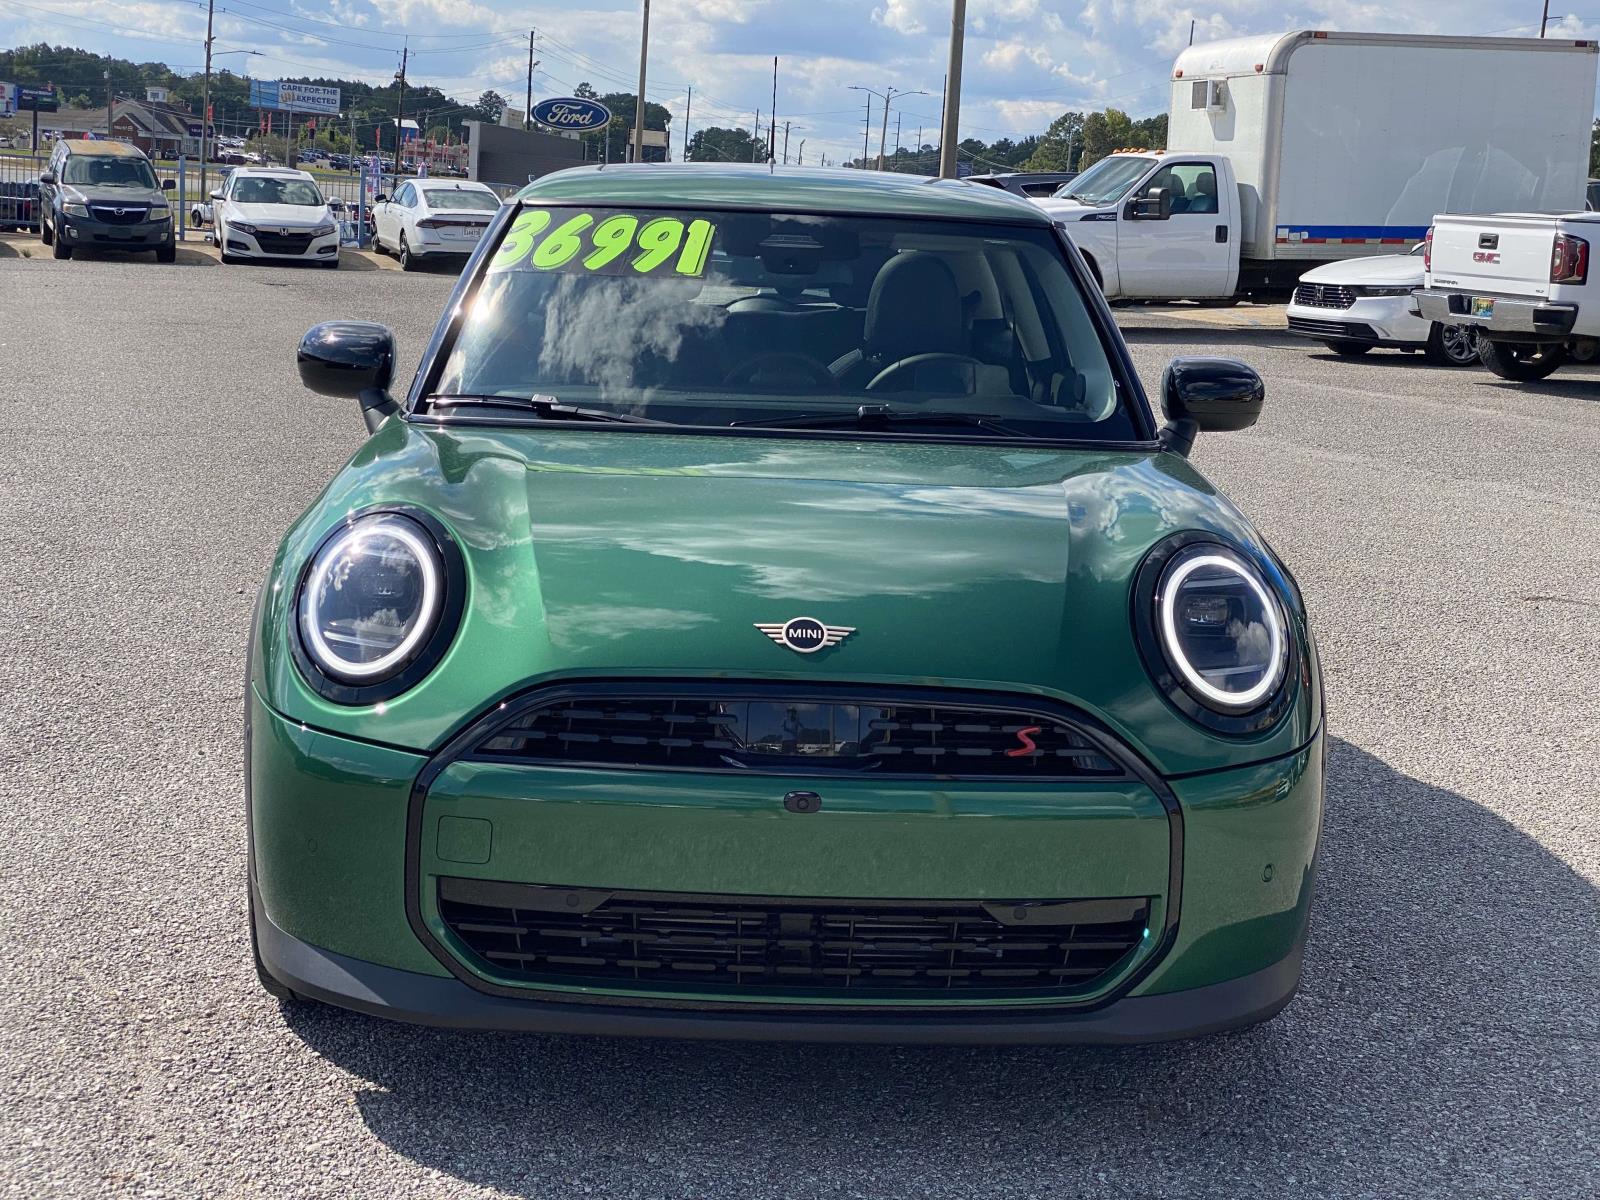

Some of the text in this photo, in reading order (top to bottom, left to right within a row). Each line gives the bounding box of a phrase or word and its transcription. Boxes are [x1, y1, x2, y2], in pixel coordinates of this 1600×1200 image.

[281, 84, 338, 96] CARE FOR THE
[296, 95, 337, 105] EXPECTED
[547, 103, 594, 125] Ford
[487, 210, 715, 277] 36991
[1473, 251, 1501, 265] GMC
[788, 628, 822, 639] MINI
[1007, 726, 1041, 757] S
